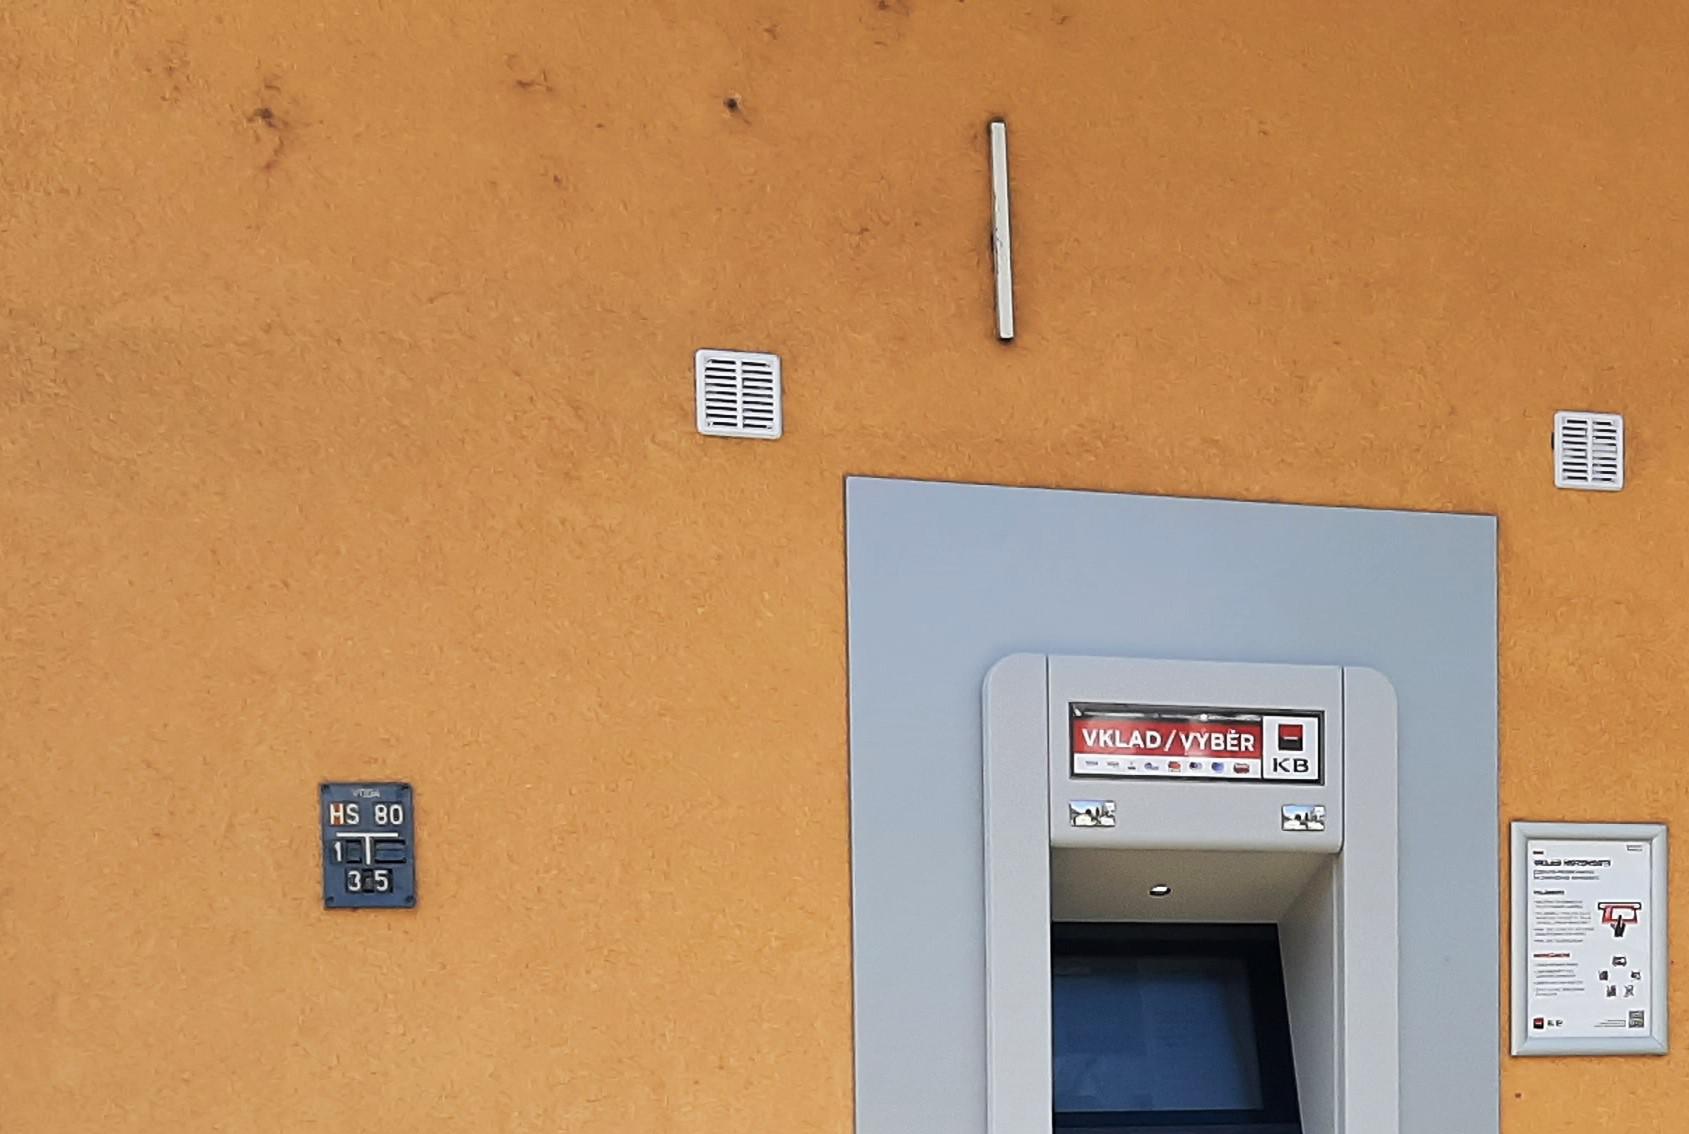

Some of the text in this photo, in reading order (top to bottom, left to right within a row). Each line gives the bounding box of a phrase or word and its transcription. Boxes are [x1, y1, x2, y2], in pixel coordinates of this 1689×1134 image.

[1273, 757, 1309, 773] KB
[330, 804, 404, 825] HS 80
